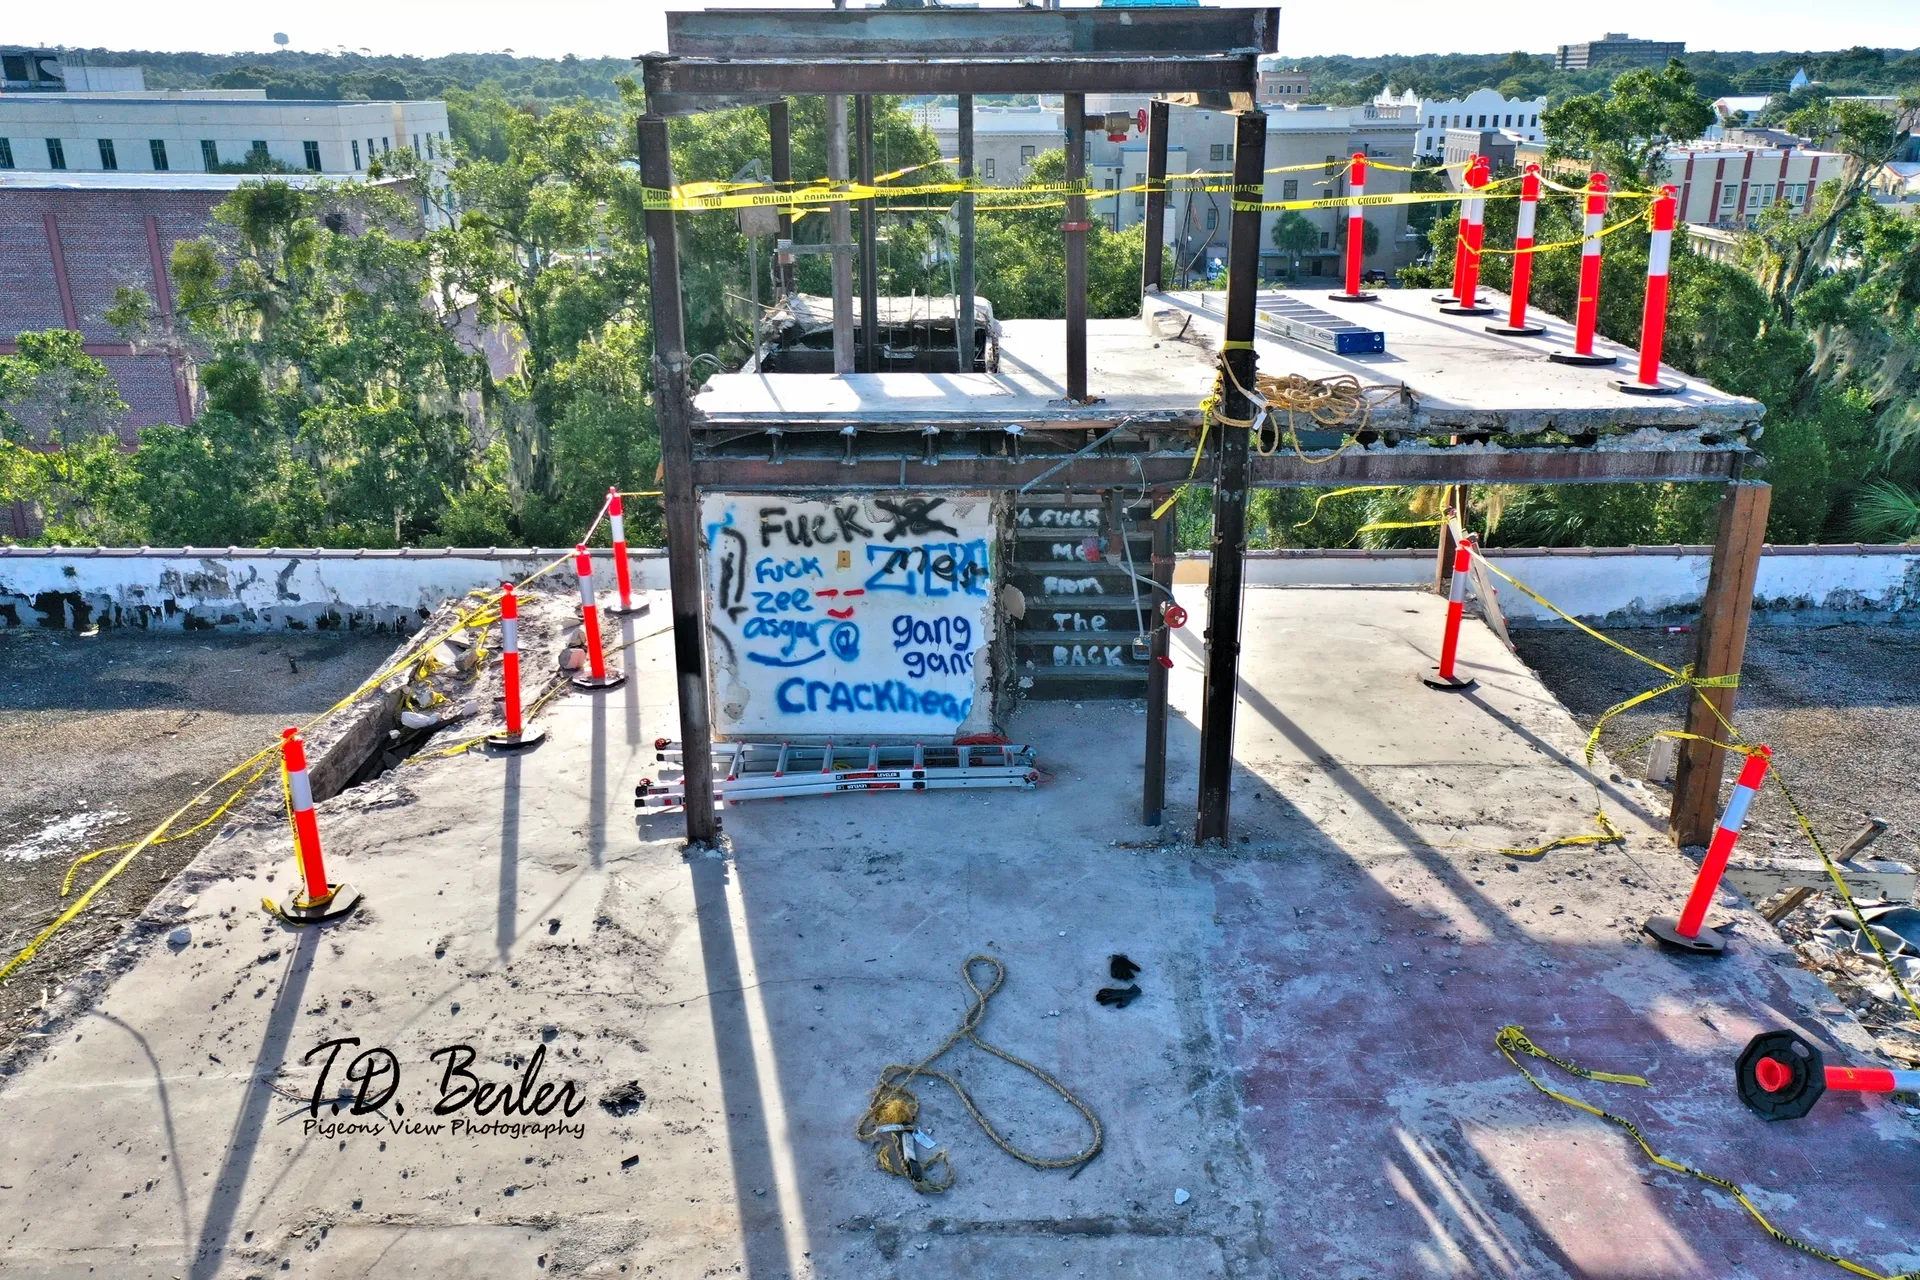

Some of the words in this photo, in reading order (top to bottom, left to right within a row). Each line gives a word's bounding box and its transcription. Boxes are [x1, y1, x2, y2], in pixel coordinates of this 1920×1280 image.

[1053, 612, 1109, 632] The
[892, 614, 972, 653] gang
[1053, 645, 1124, 667] BACK
